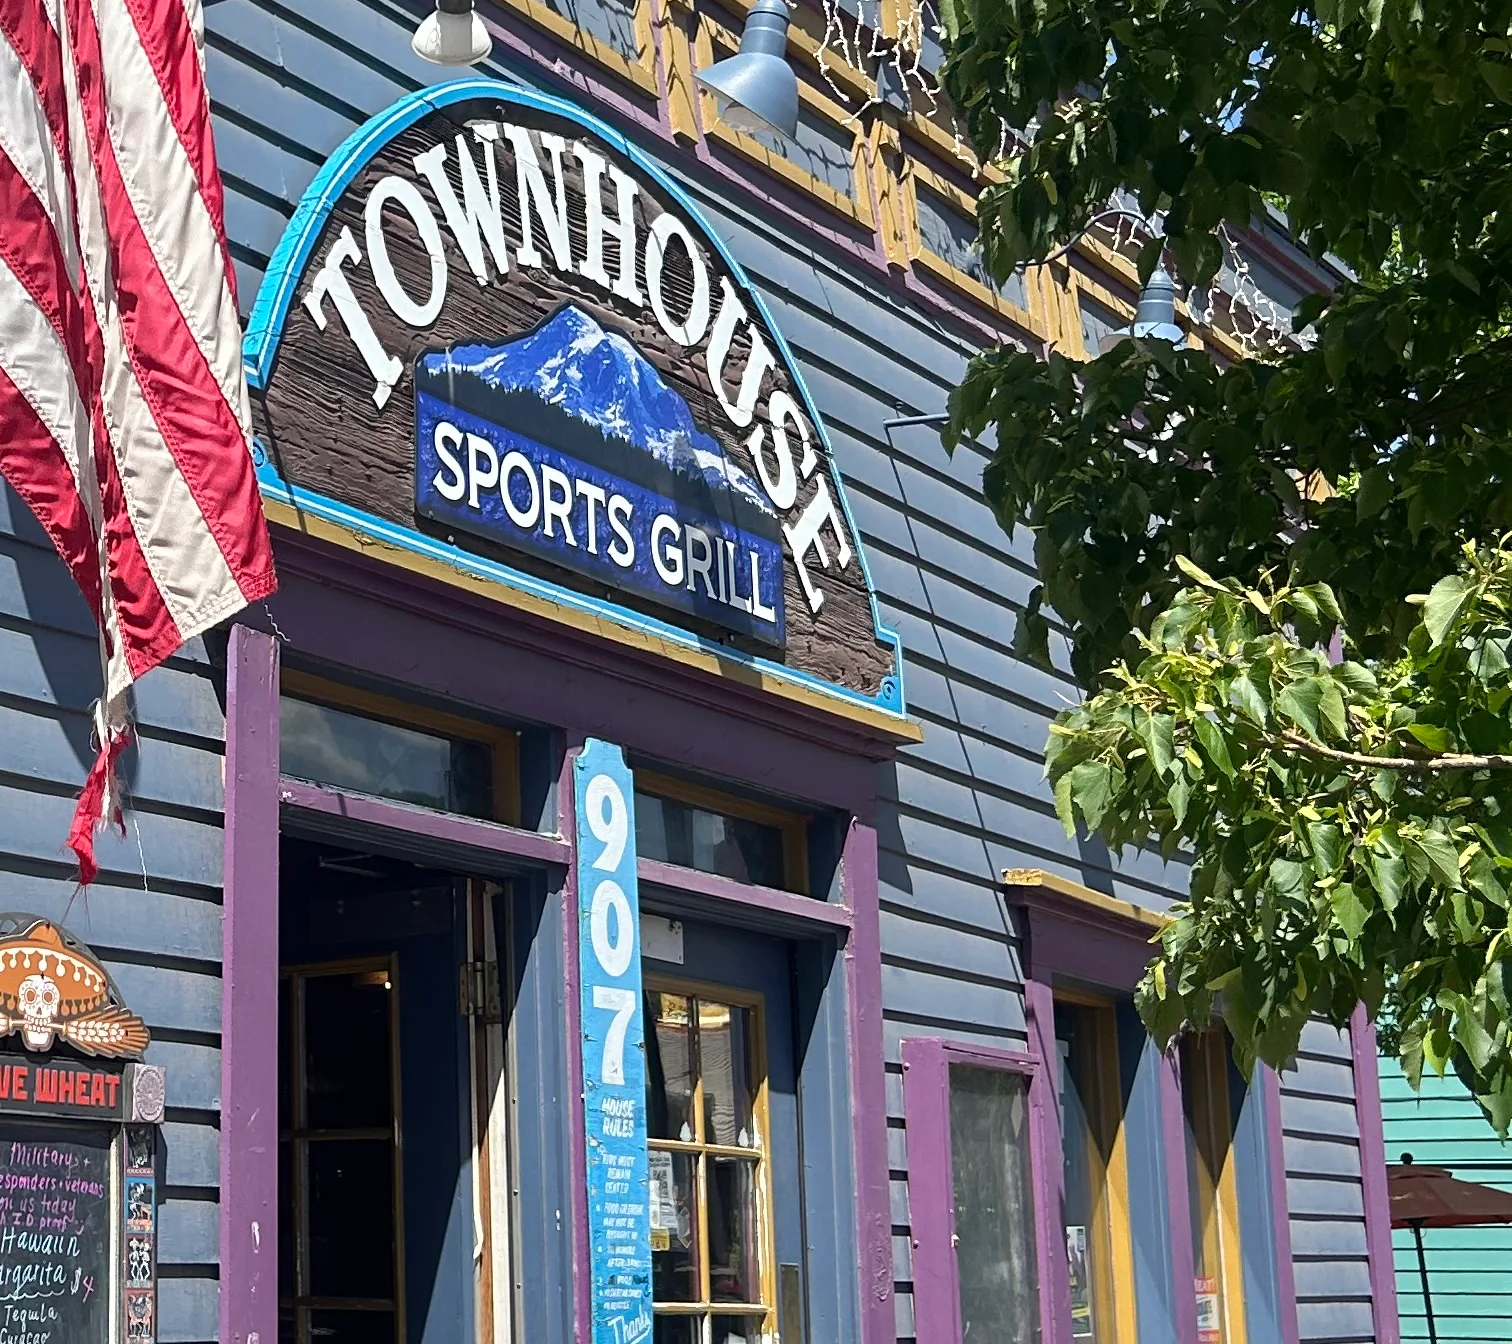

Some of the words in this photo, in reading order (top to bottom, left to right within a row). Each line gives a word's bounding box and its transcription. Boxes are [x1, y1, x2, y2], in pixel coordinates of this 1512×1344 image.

[302, 122, 851, 613] TOWNHOUSE
[432, 421, 634, 567] SPORTS
[650, 514, 776, 623] GRILL
[585, 774, 636, 1086] 907
[34, 1067, 120, 1107] WHEAT
[602, 1098, 635, 1118] HOUSE
[603, 1117, 634, 1138] RULES
[65, 1179, 105, 1198] veterans
[20, 1197, 35, 1211] us
[41, 1194, 77, 1221] today
[4, 1304, 58, 1332] Tequila
